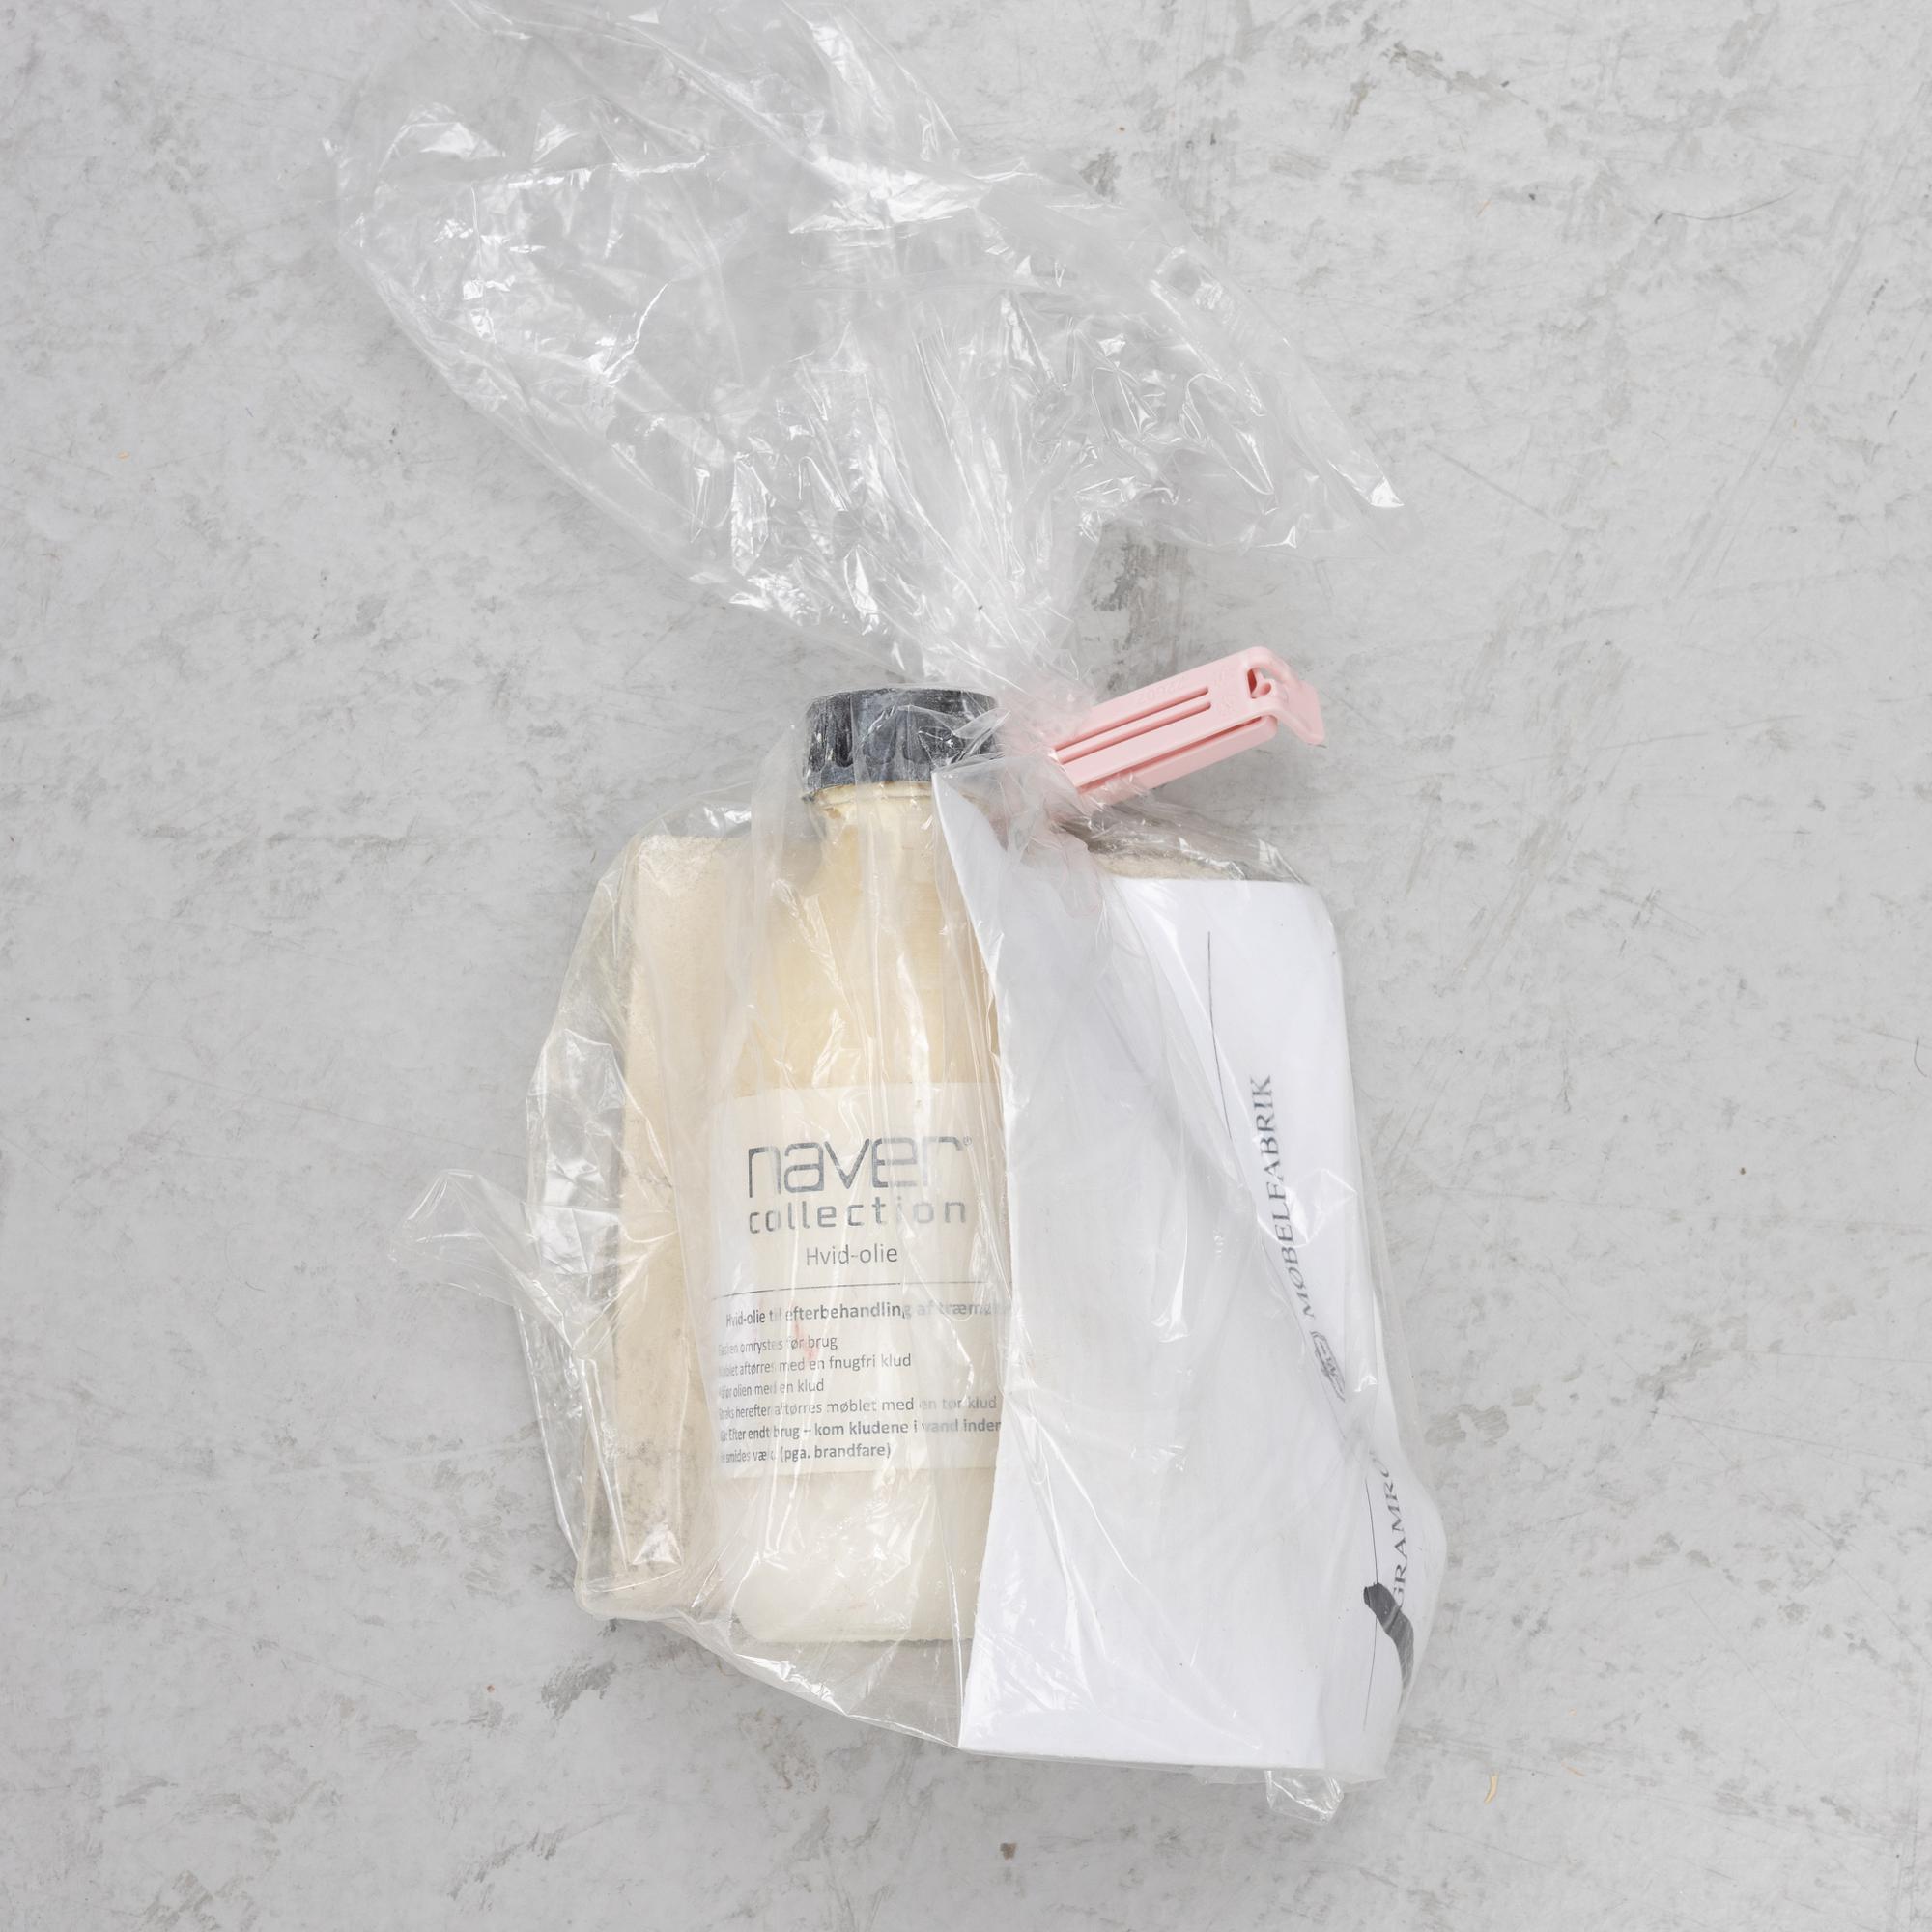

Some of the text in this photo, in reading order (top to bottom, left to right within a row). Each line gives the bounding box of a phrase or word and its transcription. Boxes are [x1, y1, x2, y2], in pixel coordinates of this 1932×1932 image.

[749, 1197, 967, 1234] collection
[806, 1243, 898, 1265] Hvid-olie
[725, 1309, 766, 1327] Hvid-olie
[786, 1337, 804, 1350] ør
[808, 1334, 838, 1350] brug
[780, 1357, 805, 1371] med
[810, 1359, 825, 1371] en
[829, 1354, 876, 1374] fnugfri
[881, 1353, 911, 1368] klud
[780, 1382, 793, 1394] en
[798, 1378, 824, 1392] klud
[735, 1404, 771, 1418] herefter
[827, 1398, 876, 1413] møblet
[882, 1397, 914, 1411] med
[968, 1395, 997, 1409] klud
[748, 1425, 770, 1439] endt
[773, 1425, 800, 1440] brug
[814, 1421, 843, 1435] kom
[849, 1419, 909, 1435] kludene
[913, 1420, 917, 1433] i
[781, 1446, 810, 1463] (pga.
[814, 1442, 891, 1460] brandfare)
